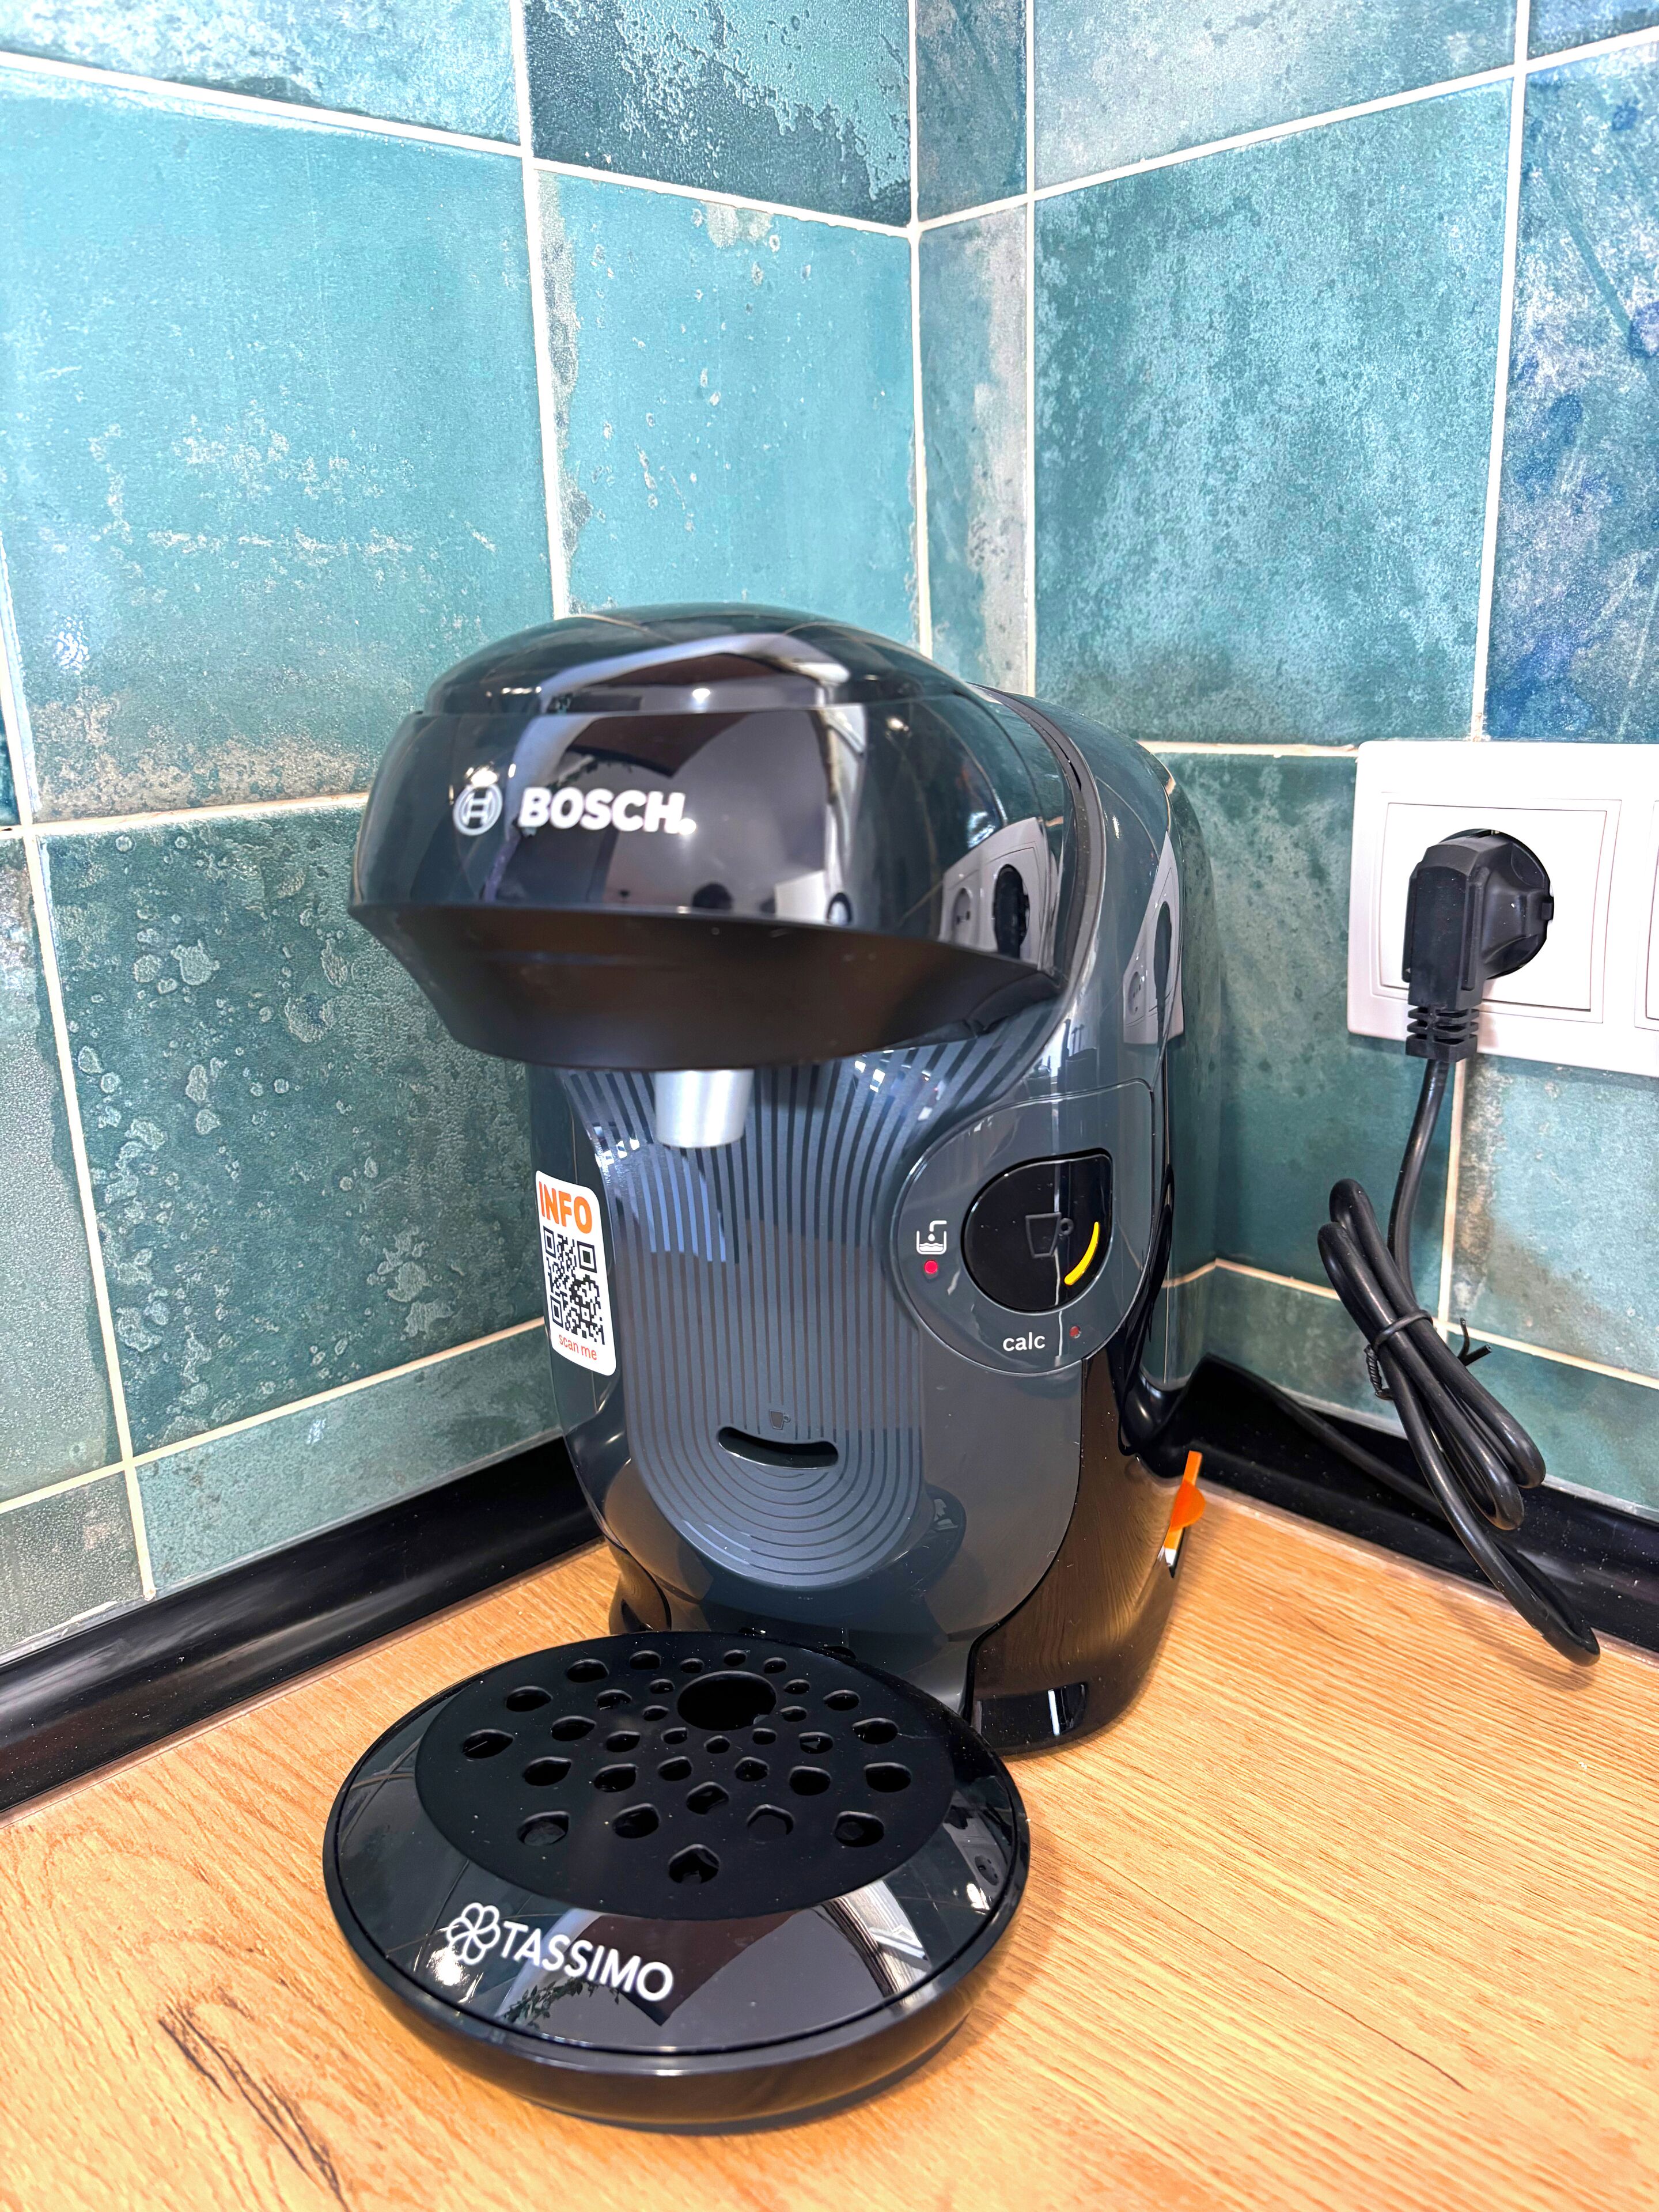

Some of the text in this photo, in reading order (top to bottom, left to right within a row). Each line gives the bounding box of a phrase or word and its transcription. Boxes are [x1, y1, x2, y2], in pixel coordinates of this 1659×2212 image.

[518, 787, 686, 834] BOSCH
[539, 1181, 593, 1234] INFO
[559, 1334, 597, 1361] scan me
[1002, 1332, 1046, 1351] calc
[501, 1920, 674, 2002] TASSIMO
